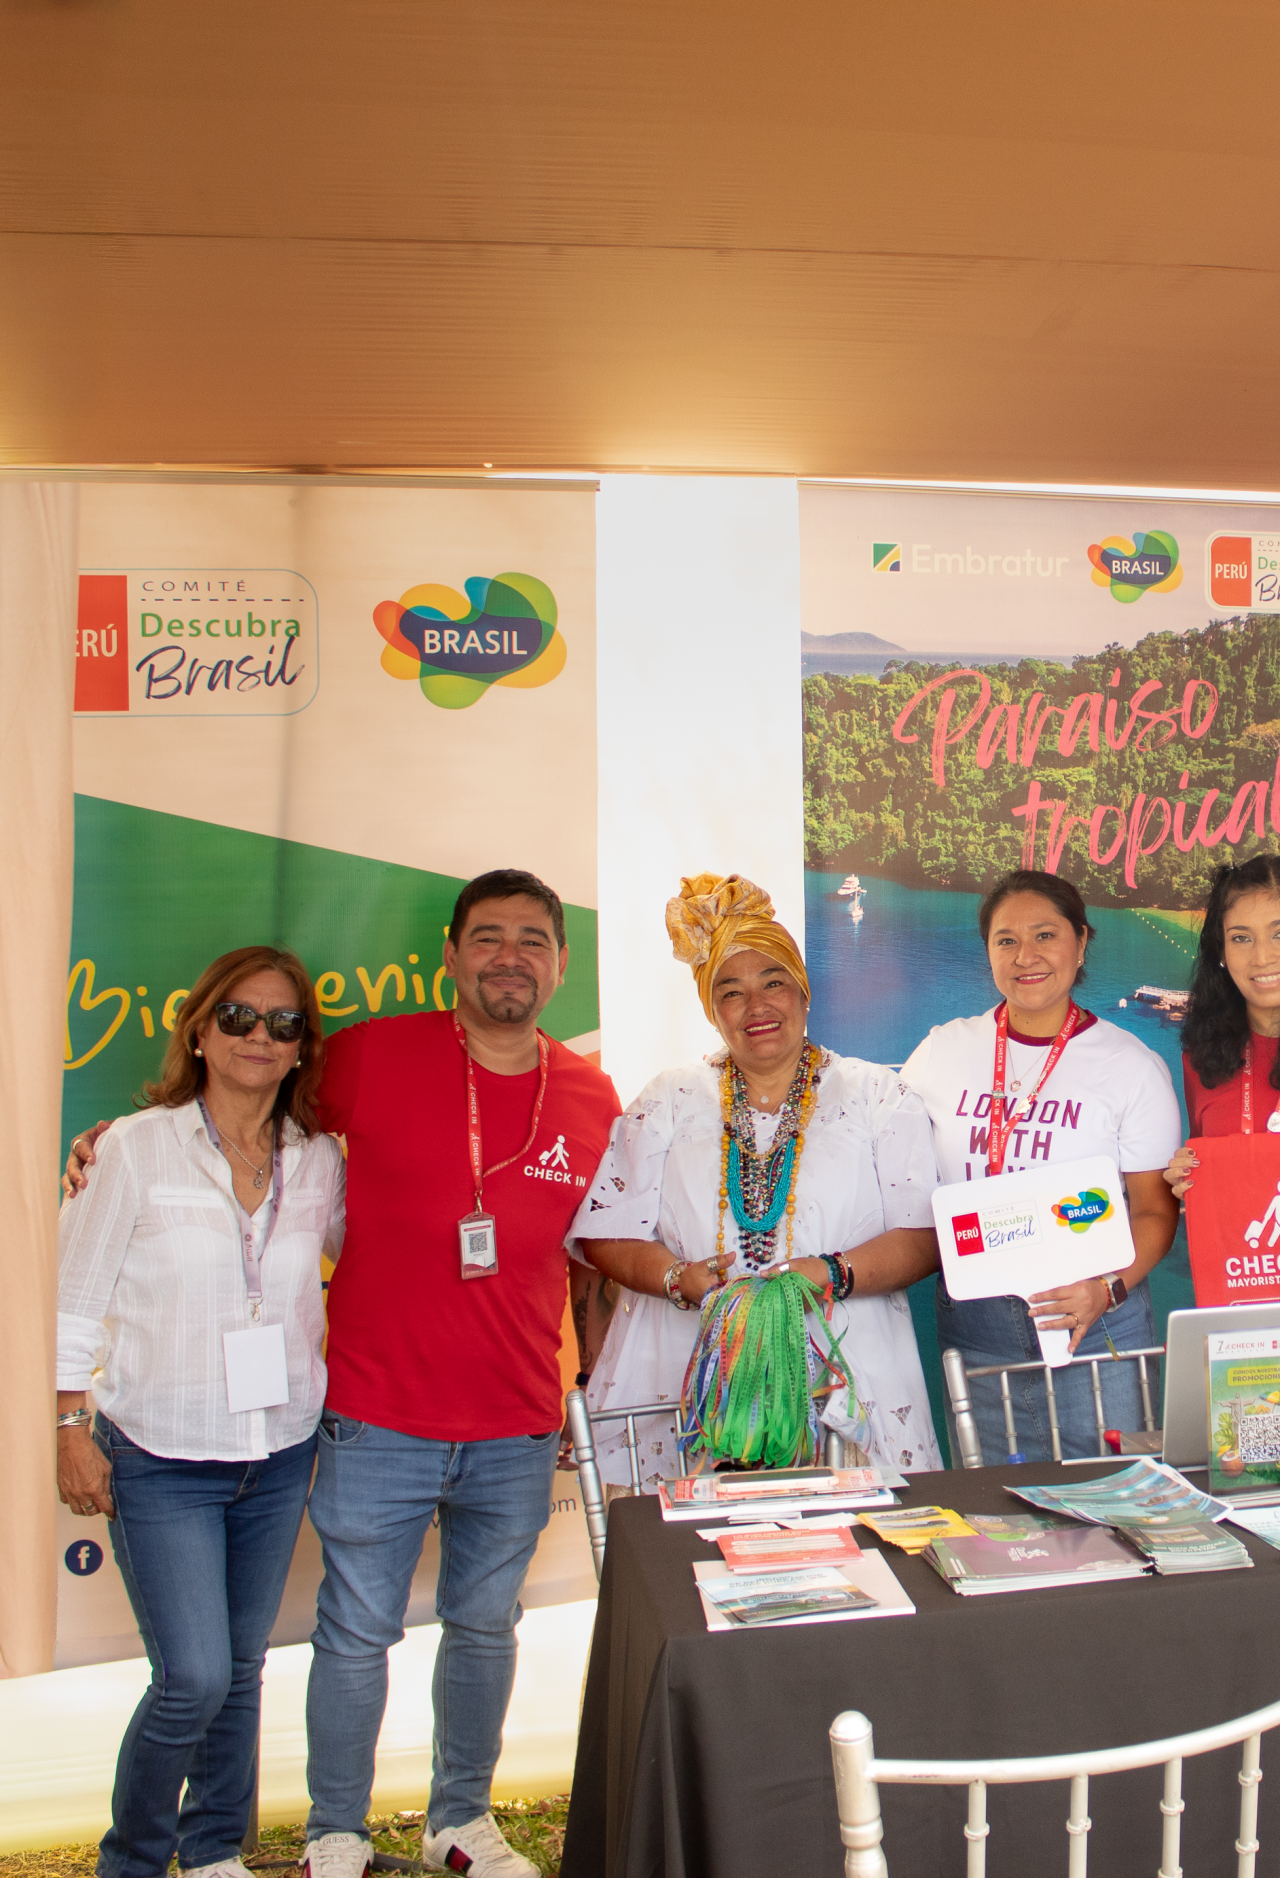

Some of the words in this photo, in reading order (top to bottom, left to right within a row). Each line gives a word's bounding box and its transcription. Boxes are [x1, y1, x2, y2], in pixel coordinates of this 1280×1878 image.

[912, 544, 1070, 578] Embratur
[1111, 557, 1165, 577] BRASIL
[1214, 561, 1248, 581] PERÚ
[142, 578, 248, 592] COMITÉ
[140, 612, 302, 638] Descubra
[424, 628, 528, 656] BRASIL
[136, 634, 305, 700] Brasil
[1064, 1015, 1075, 1033] CHECK
[1045, 1053, 1056, 1071] HECK
[1054, 1046, 1060, 1055] IN
[997, 1064, 1002, 1072] IN
[994, 1107, 1000, 1115] IN
[471, 1116, 477, 1124] IN
[970, 1125, 1052, 1160] WTH
[992, 1152, 998, 1163] IN
[474, 1168, 480, 1176] IN
[523, 1165, 572, 1184] CHECK
[575, 1175, 586, 1187] IN
[1067, 1204, 1103, 1219] BRASIL
[984, 1213, 1034, 1230] Descubra
[956, 1226, 979, 1241] PERÚ
[985, 1220, 1037, 1248] Brasil
[1231, 1342, 1255, 1350] CHECK
[322, 1835, 350, 1846] GUESS
